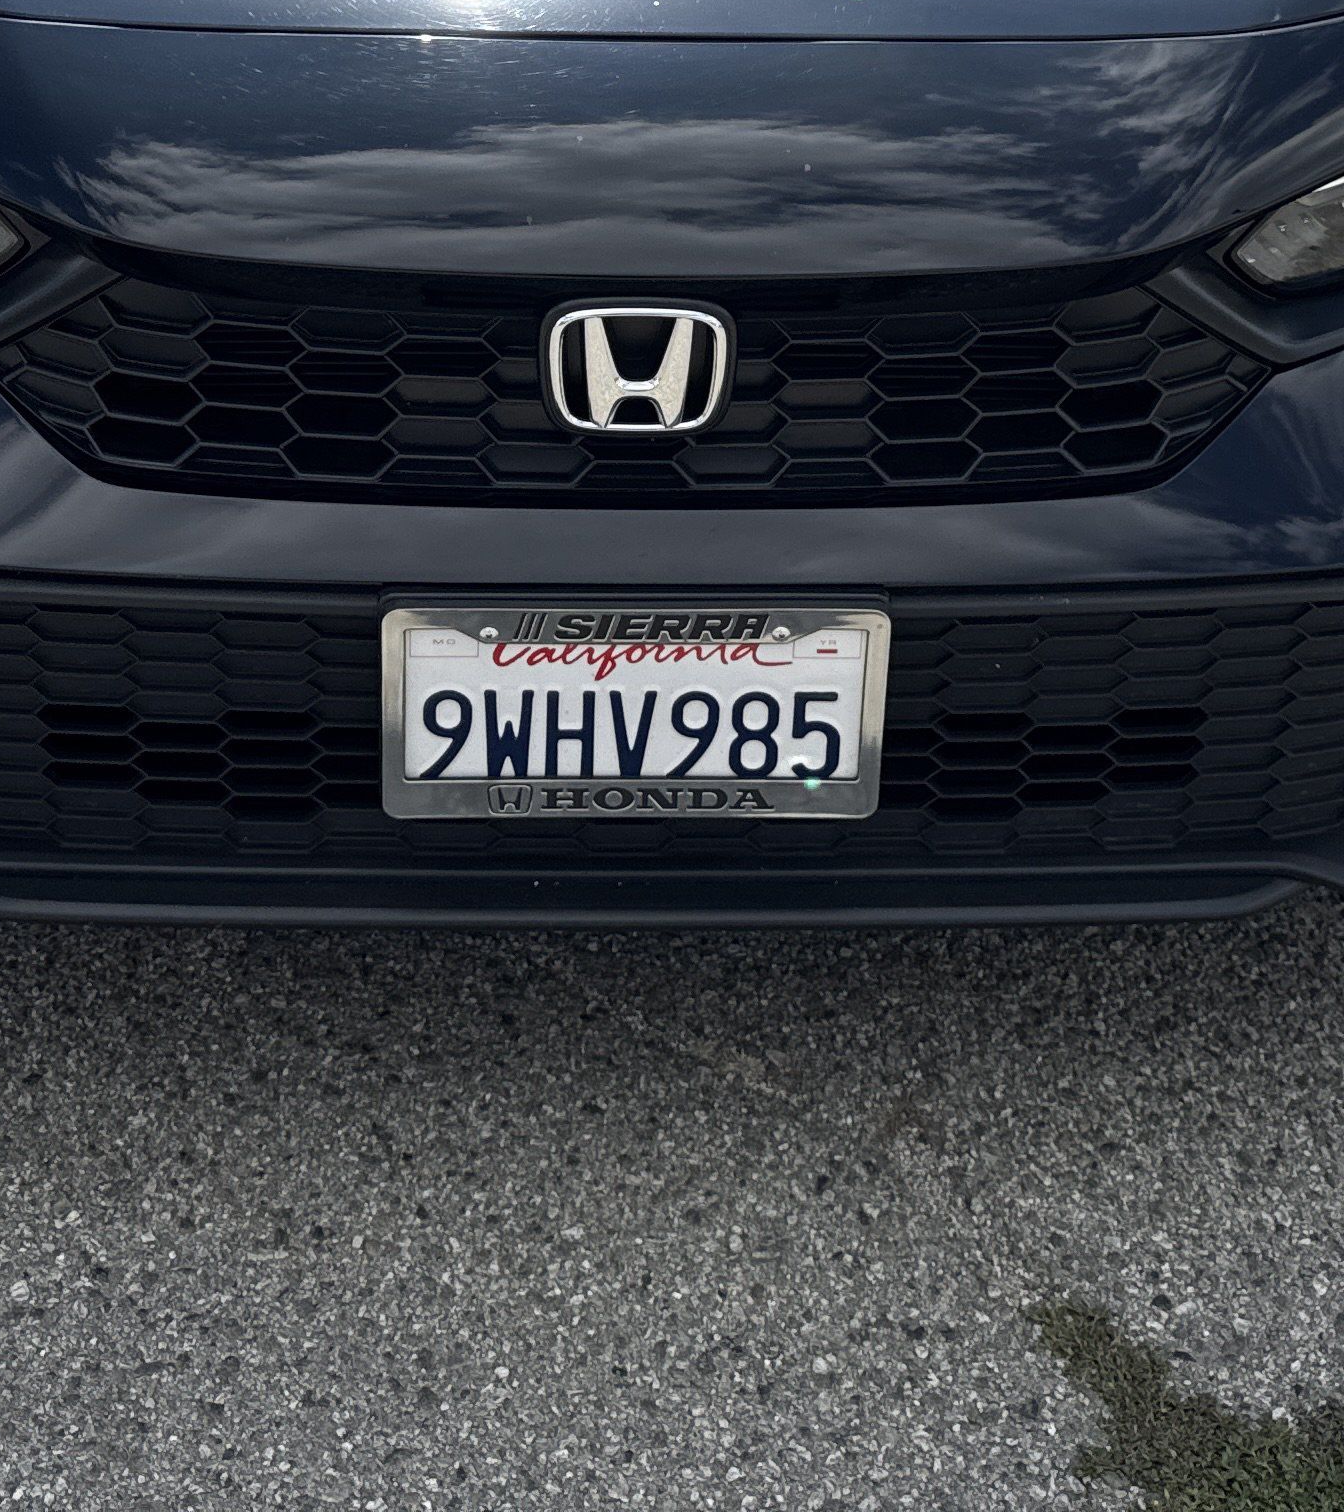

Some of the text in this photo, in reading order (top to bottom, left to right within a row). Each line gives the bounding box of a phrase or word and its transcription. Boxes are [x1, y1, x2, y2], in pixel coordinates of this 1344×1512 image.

[554, 614, 770, 641] SIERRA
[419, 689, 842, 780] 9WHV985
[541, 787, 775, 811] HONDA
